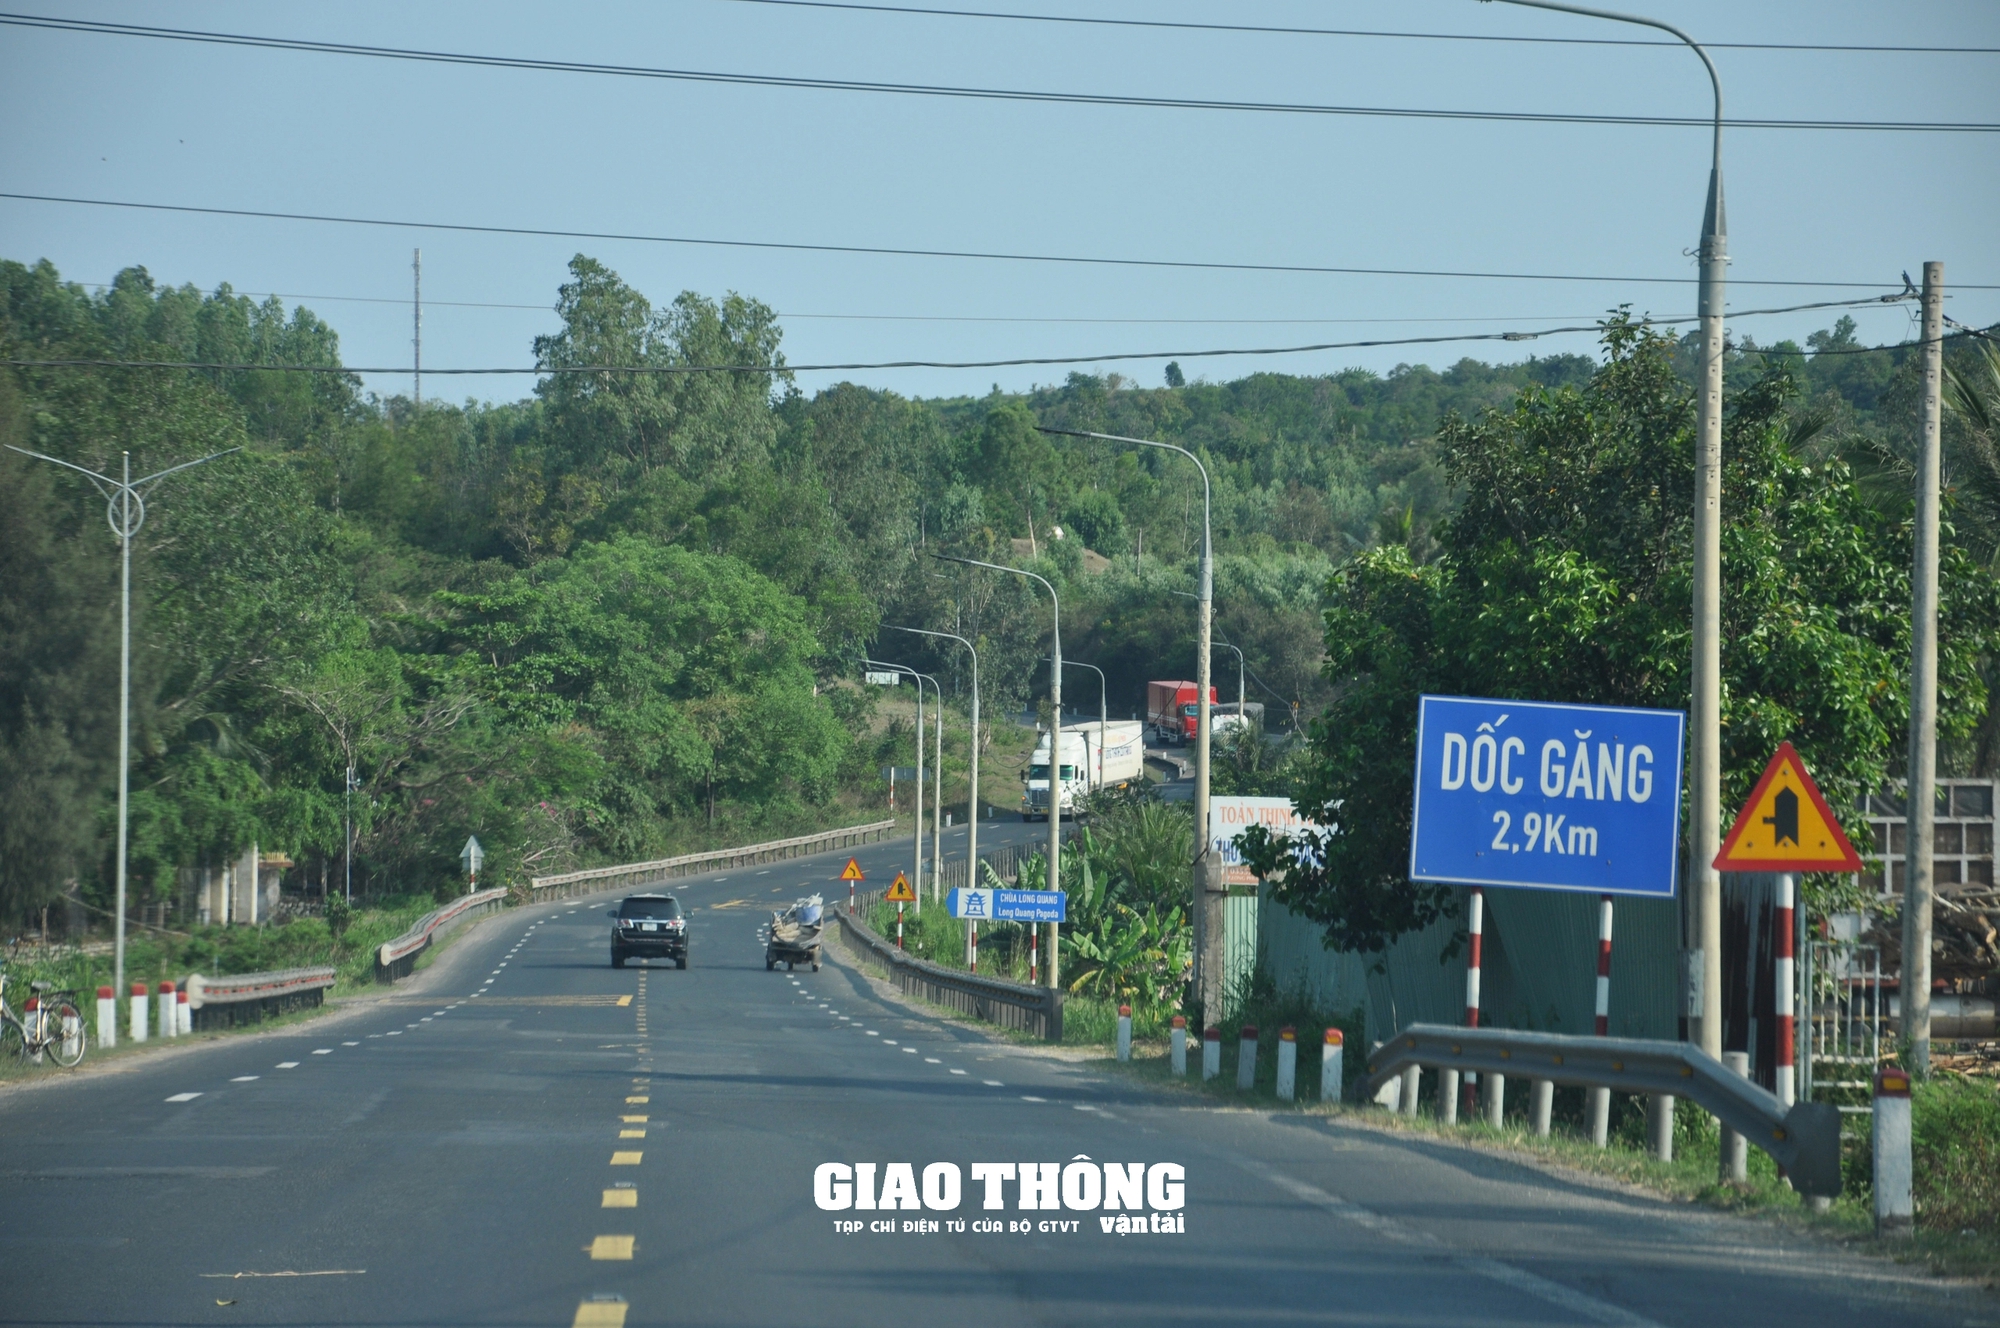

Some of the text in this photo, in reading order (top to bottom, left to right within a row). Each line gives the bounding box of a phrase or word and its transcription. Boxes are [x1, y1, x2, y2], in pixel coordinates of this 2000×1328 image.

[1441, 714, 1655, 803] DỐC GĂNG
[1491, 810, 1599, 857] 2,9Km
[998, 907, 1059, 920] Long Quang Pagoda
[1000, 892, 1058, 905] CHÙA LONG QUANG
